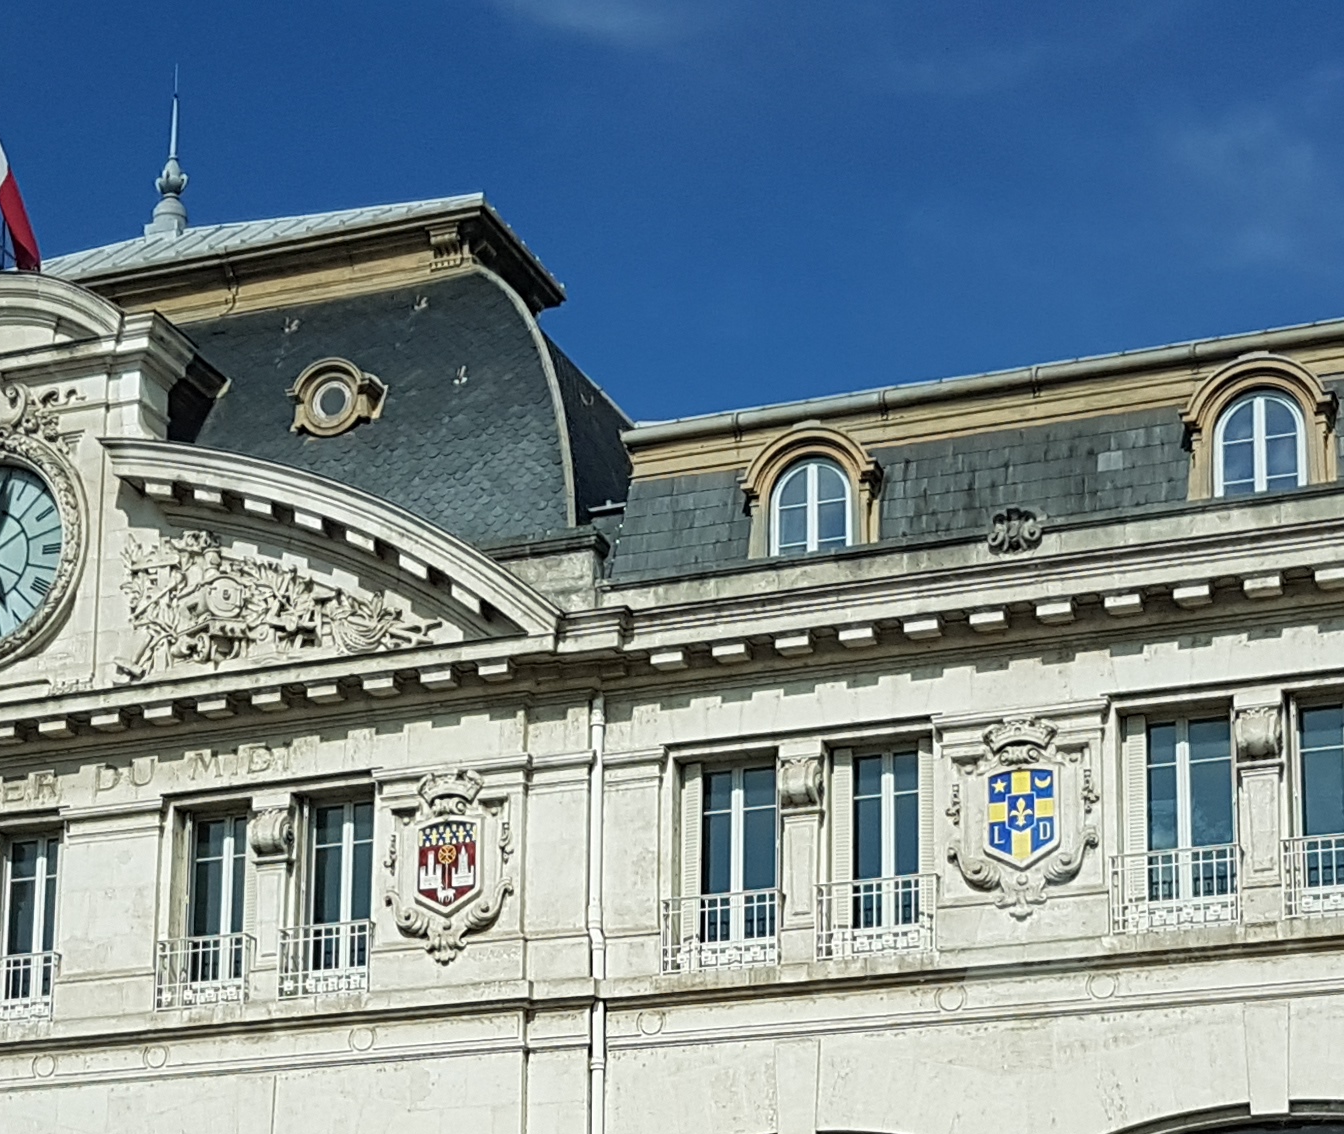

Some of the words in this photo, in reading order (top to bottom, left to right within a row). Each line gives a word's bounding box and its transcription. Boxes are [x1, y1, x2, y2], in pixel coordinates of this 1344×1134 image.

[94, 757, 156, 797] DU
[190, 743, 293, 781] MIDI
[993, 825, 1006, 844] L
[1039, 821, 1051, 840] D
